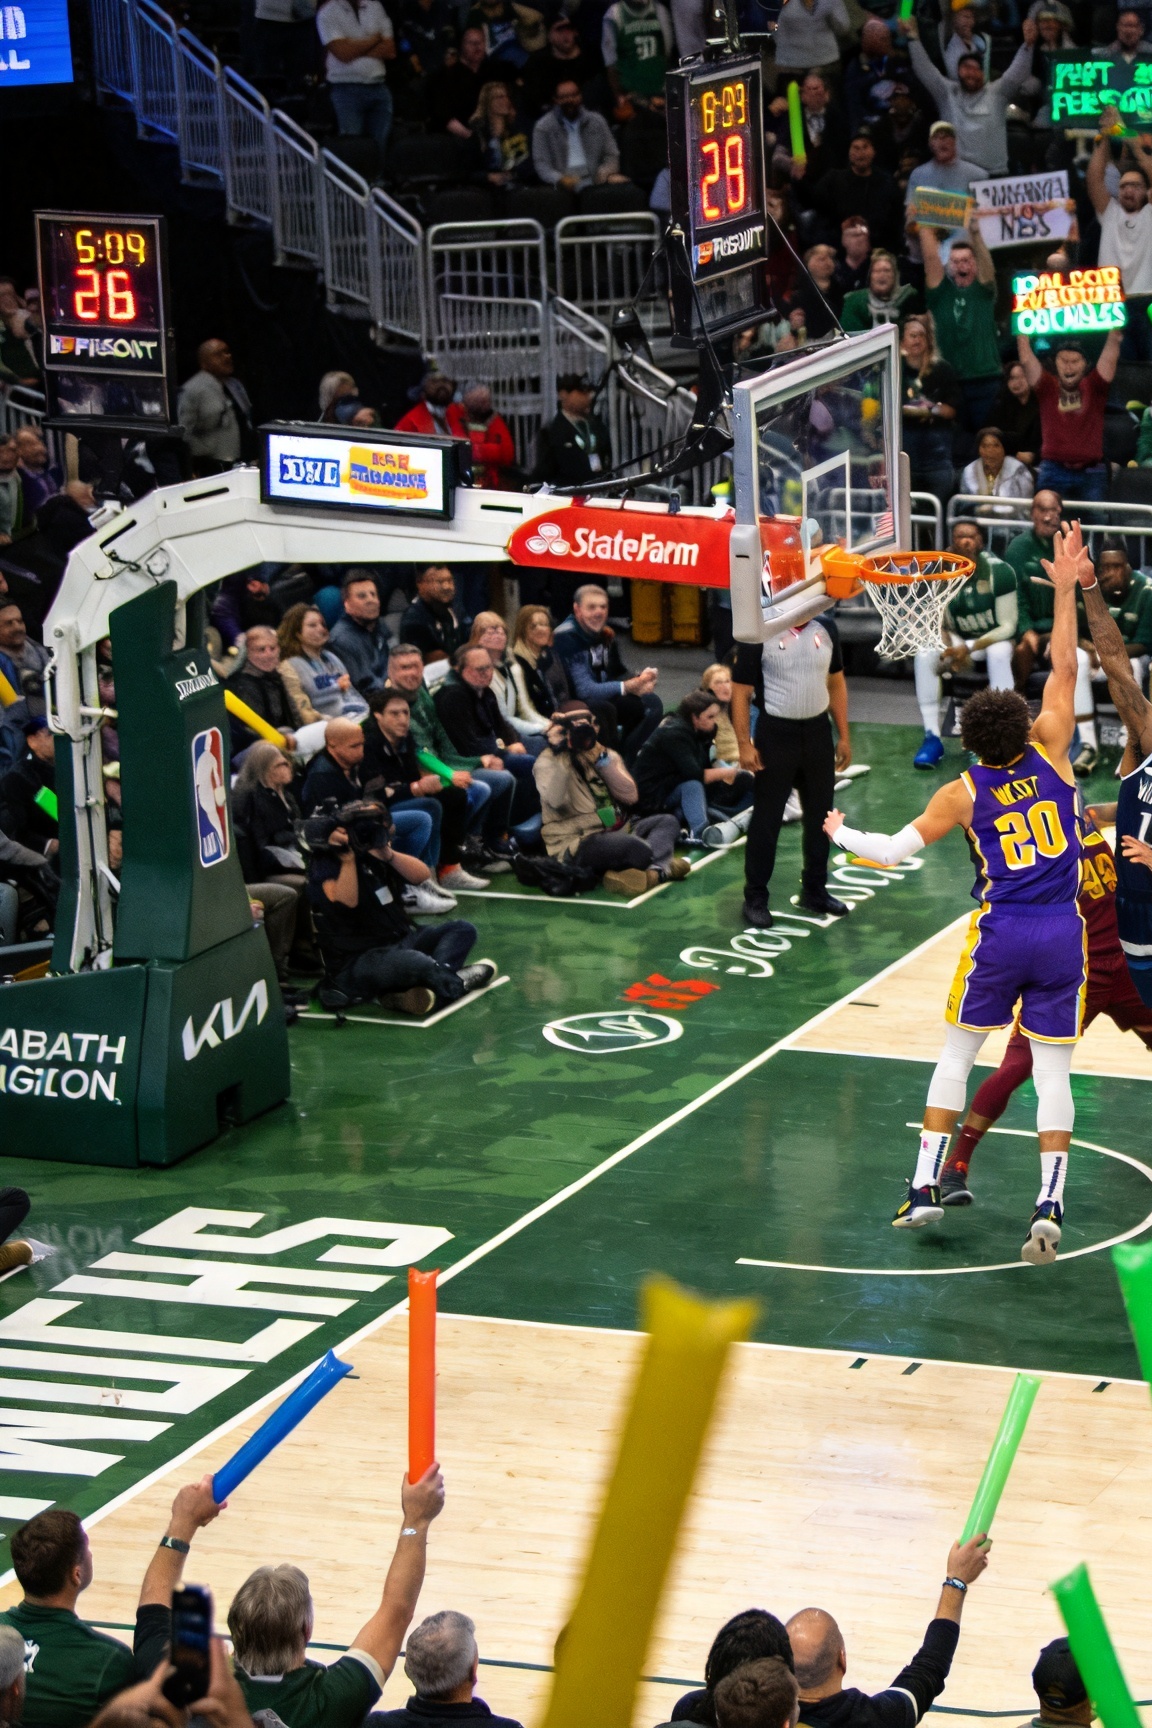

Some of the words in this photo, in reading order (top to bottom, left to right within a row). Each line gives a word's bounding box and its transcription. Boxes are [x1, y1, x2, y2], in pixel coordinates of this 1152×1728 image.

[76, 230, 146, 265] 5:09
[75, 268, 136, 320] 26
[993, 800, 1069, 871] 20
